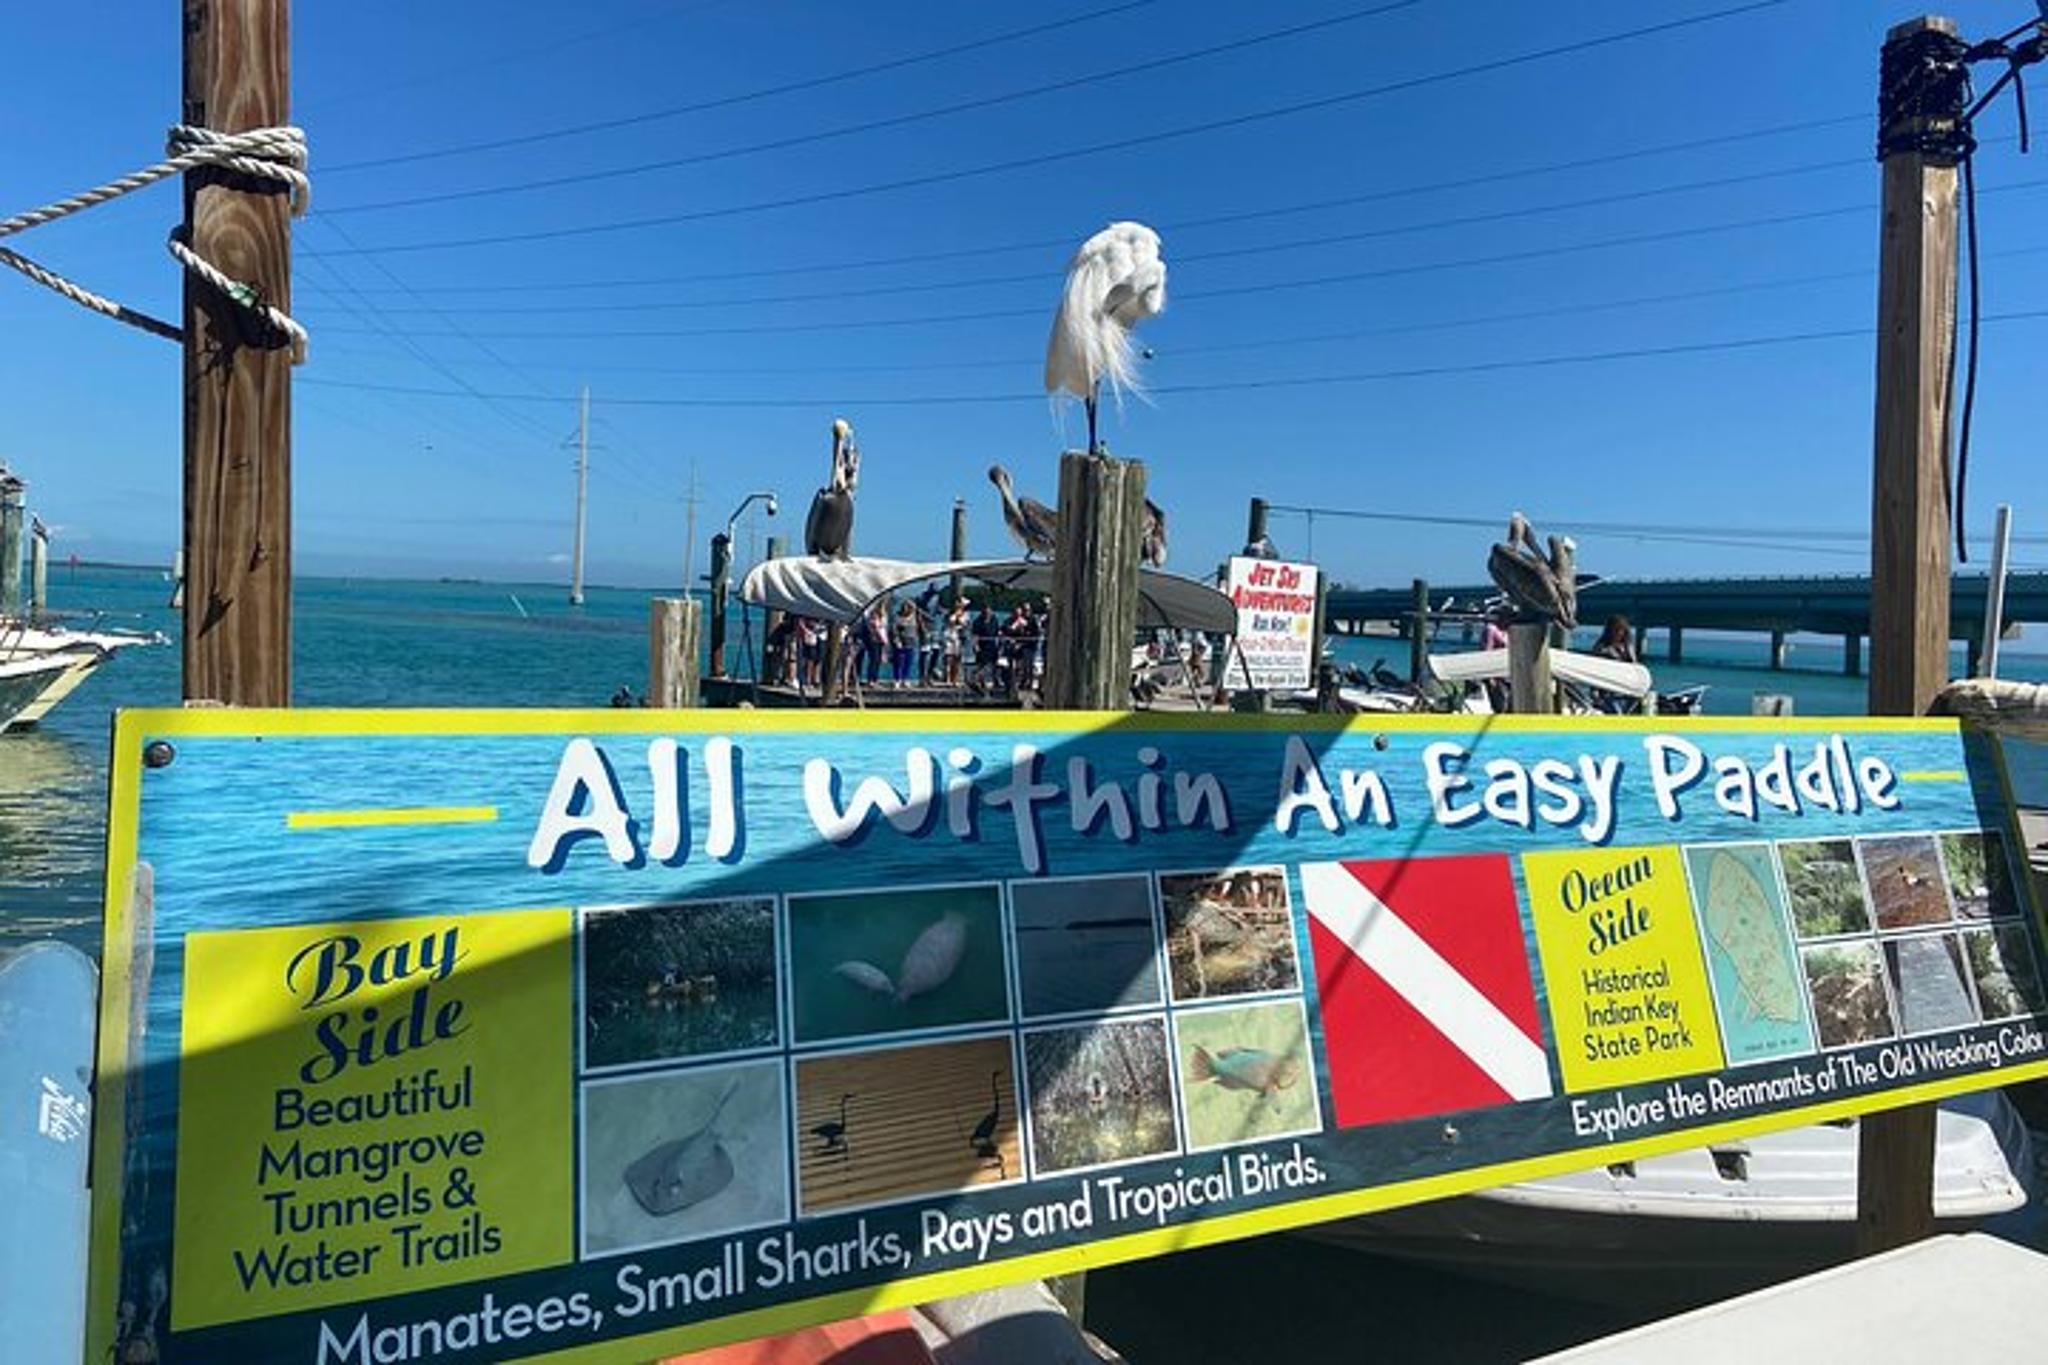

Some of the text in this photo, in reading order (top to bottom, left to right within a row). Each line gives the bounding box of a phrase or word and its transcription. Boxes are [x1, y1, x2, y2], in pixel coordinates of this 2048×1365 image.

[528, 734, 1901, 873] All Within An Easy Paddle
[1560, 855, 1654, 914] Ocean
[1588, 898, 1651, 956] Side
[287, 926, 470, 1009] Bay
[1582, 958, 1671, 996] Historical
[300, 989, 472, 1085] Side
[1583, 1021, 1693, 1062] State Park
[1584, 993, 1681, 1028] Indian Key
[274, 1065, 473, 1132] Beautiful
[1571, 1092, 1666, 1142] Explore
[1667, 1082, 1707, 1119] the
[1707, 1066, 1816, 1114] Remnants
[1816, 1056, 1840, 1092] of
[1838, 1053, 1879, 1091] The
[1879, 1043, 1917, 1079] Old
[1913, 1033, 2001, 1071] Wrecking
[258, 1130, 485, 1185] Mangrove
[264, 1166, 477, 1235] Tunnels &
[233, 1212, 502, 1292] Water Trails
[315, 1142, 1327, 1365] Manatees, Small Sharks, Rays and Tropical Birds.
